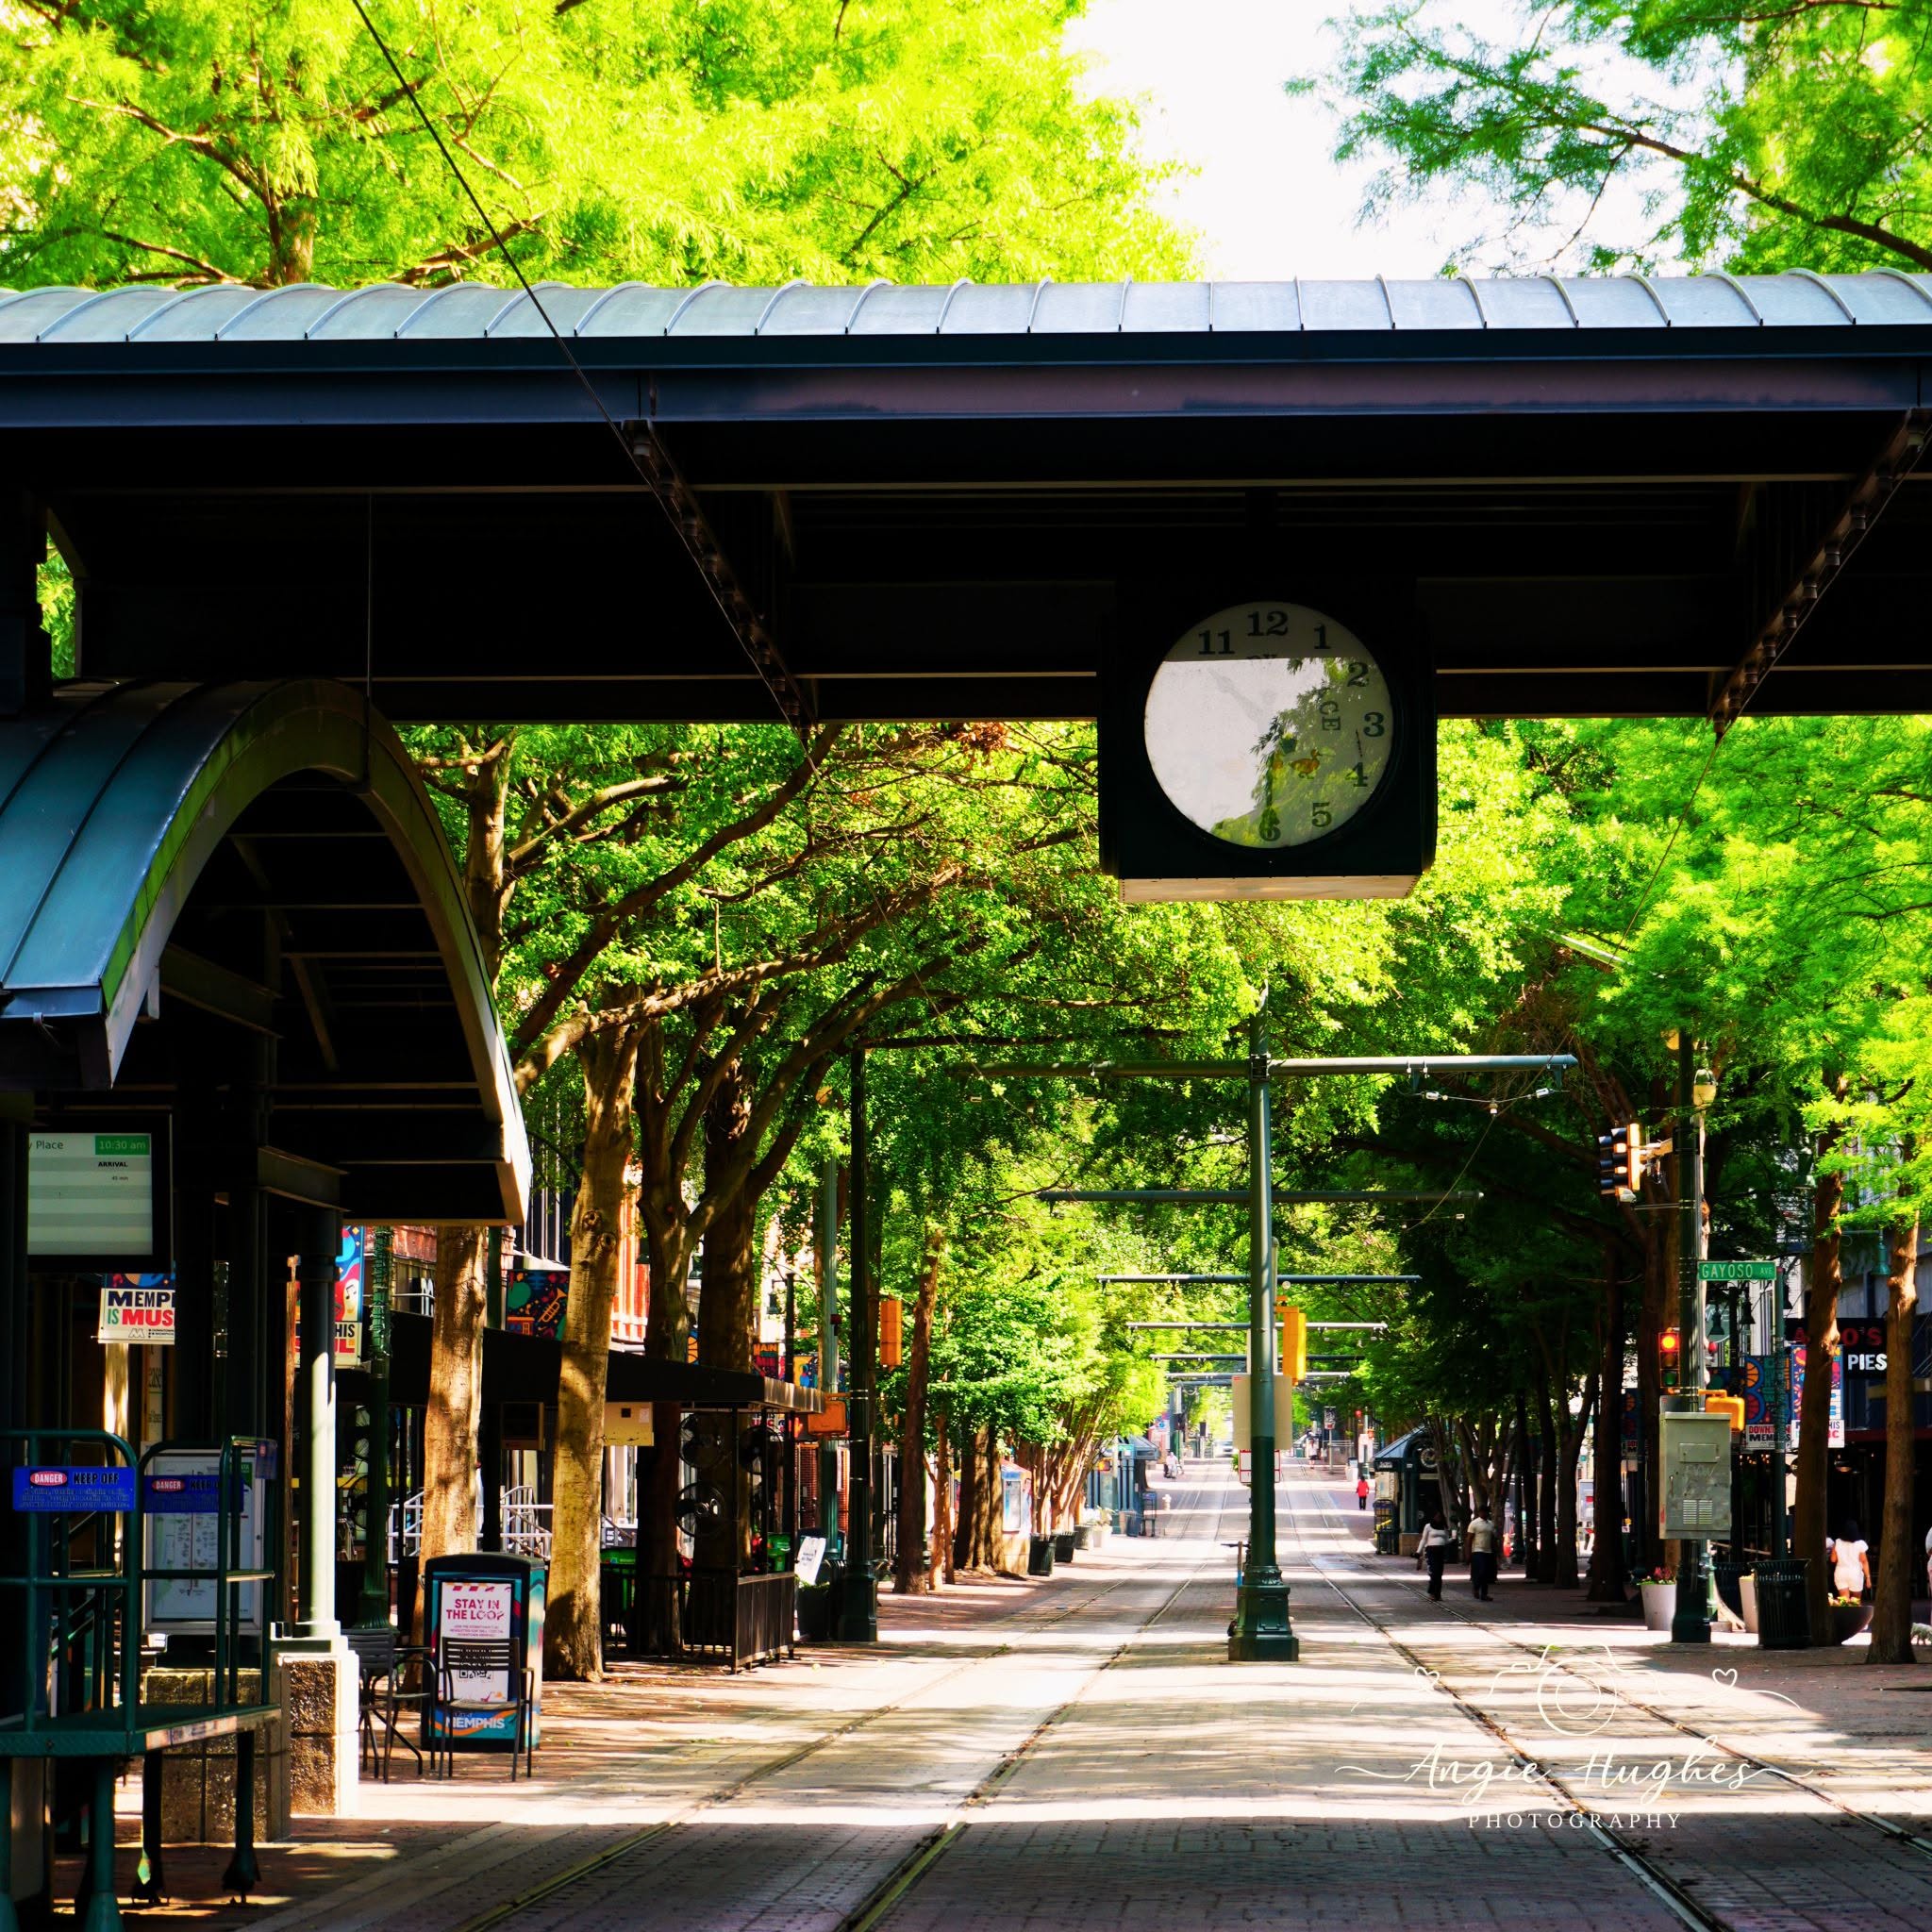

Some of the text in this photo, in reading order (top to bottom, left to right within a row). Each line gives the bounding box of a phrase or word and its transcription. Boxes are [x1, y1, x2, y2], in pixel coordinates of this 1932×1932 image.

[1247, 611, 1289, 637] 12
[1198, 629, 1235, 655] 11
[1313, 624, 1331, 650] 1
[1347, 662, 1370, 688] 2
[1363, 712, 1385, 738] 3
[1345, 762, 1368, 787] 4
[1311, 802, 1332, 827] 5
[36, 1141, 64, 1150] Place
[99, 1141, 126, 1150] 10:30
[1702, 1264, 1773, 1278] GAYOSO AVE
[108, 1308, 119, 1324] IS
[1847, 1354, 1888, 1371] PIES
[34, 1473, 119, 1485] DANGER KEEP OFF
[156, 1480, 181, 1490] DANGER
[455, 1599, 500, 1609] STAY IN
[446, 1609, 467, 1620] THE
